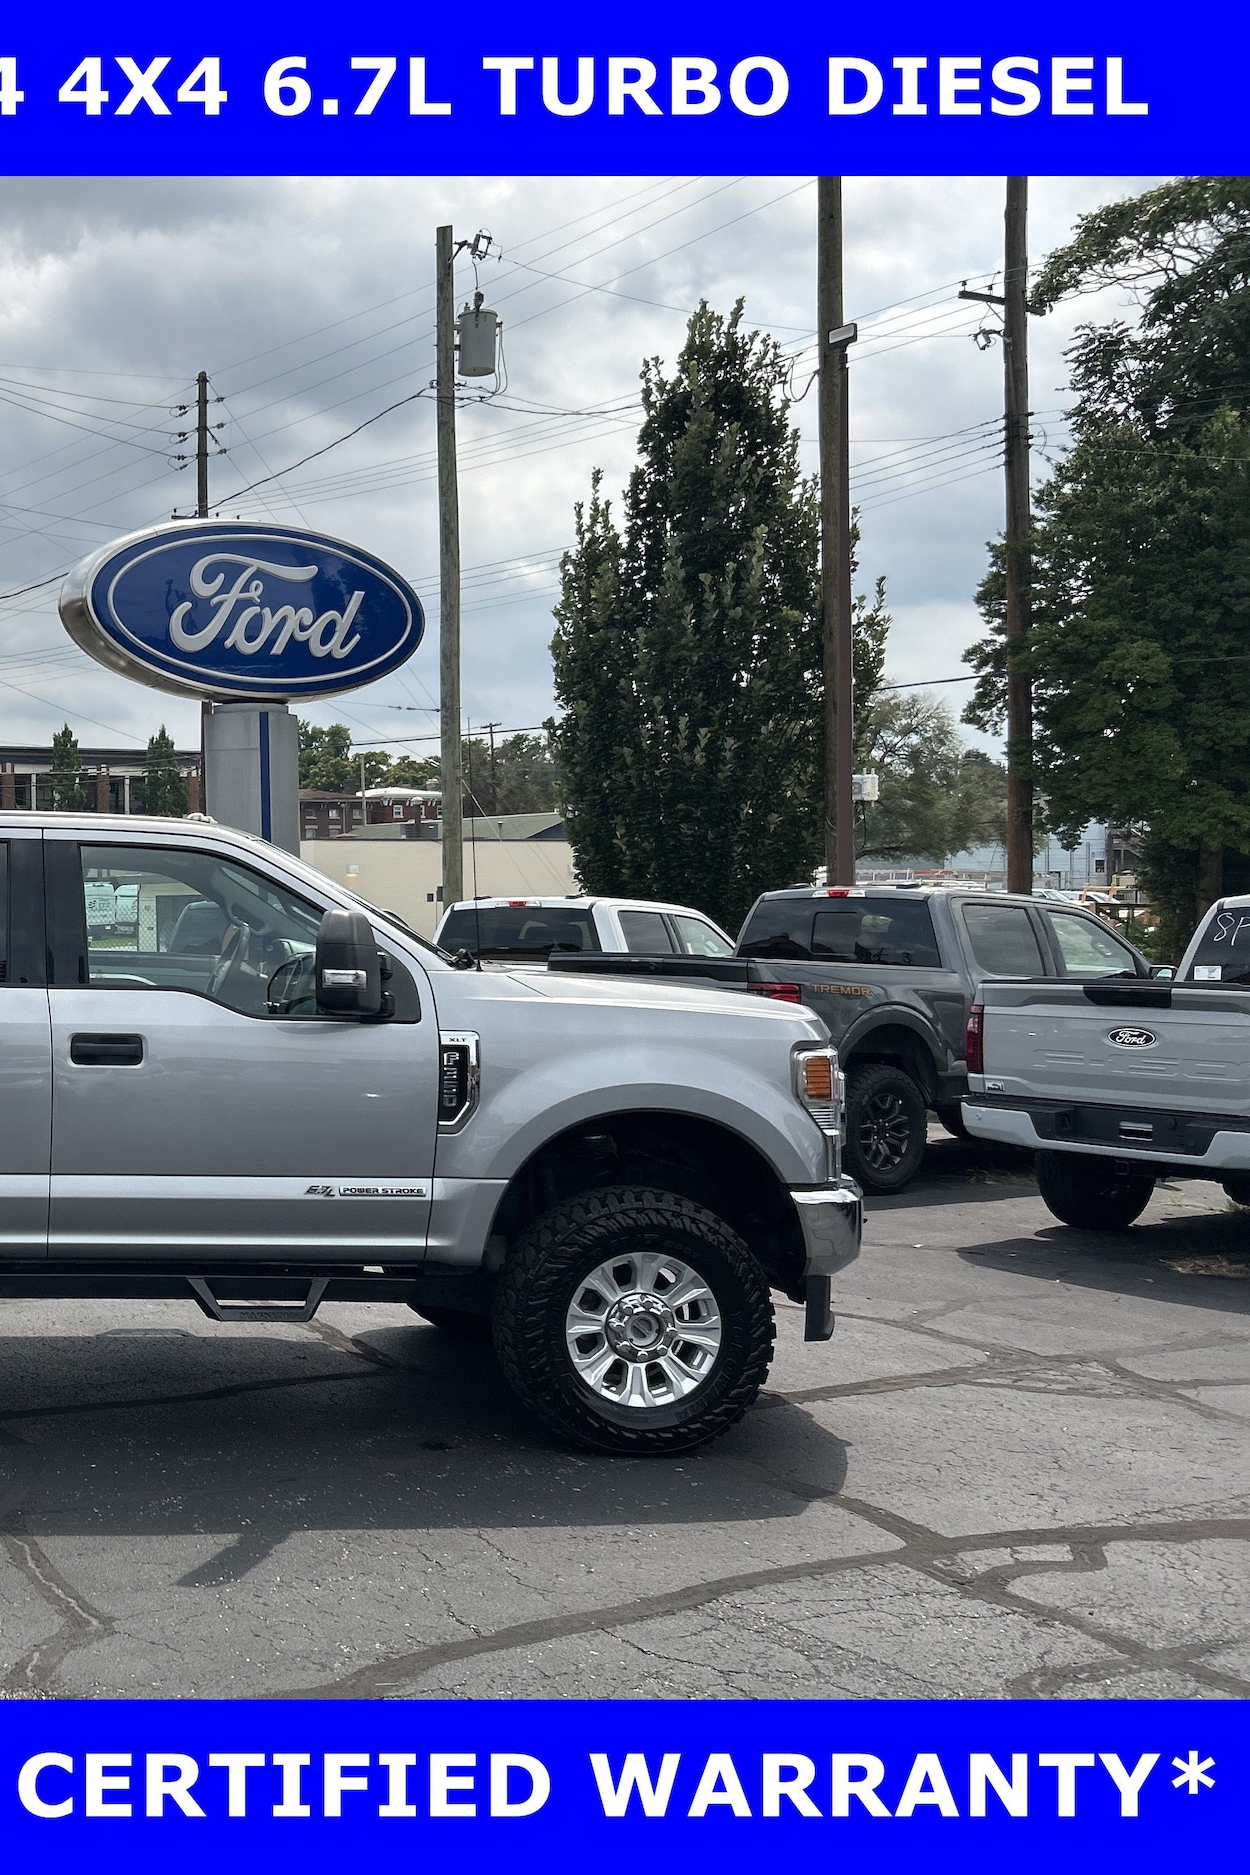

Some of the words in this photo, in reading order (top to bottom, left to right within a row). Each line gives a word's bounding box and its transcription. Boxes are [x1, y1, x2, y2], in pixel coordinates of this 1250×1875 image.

[169, 553, 365, 659] Ford
[811, 983, 872, 996] TREMOR
[1115, 1030, 1147, 1044] Ford
[381, 1187, 424, 1195] STROKE
